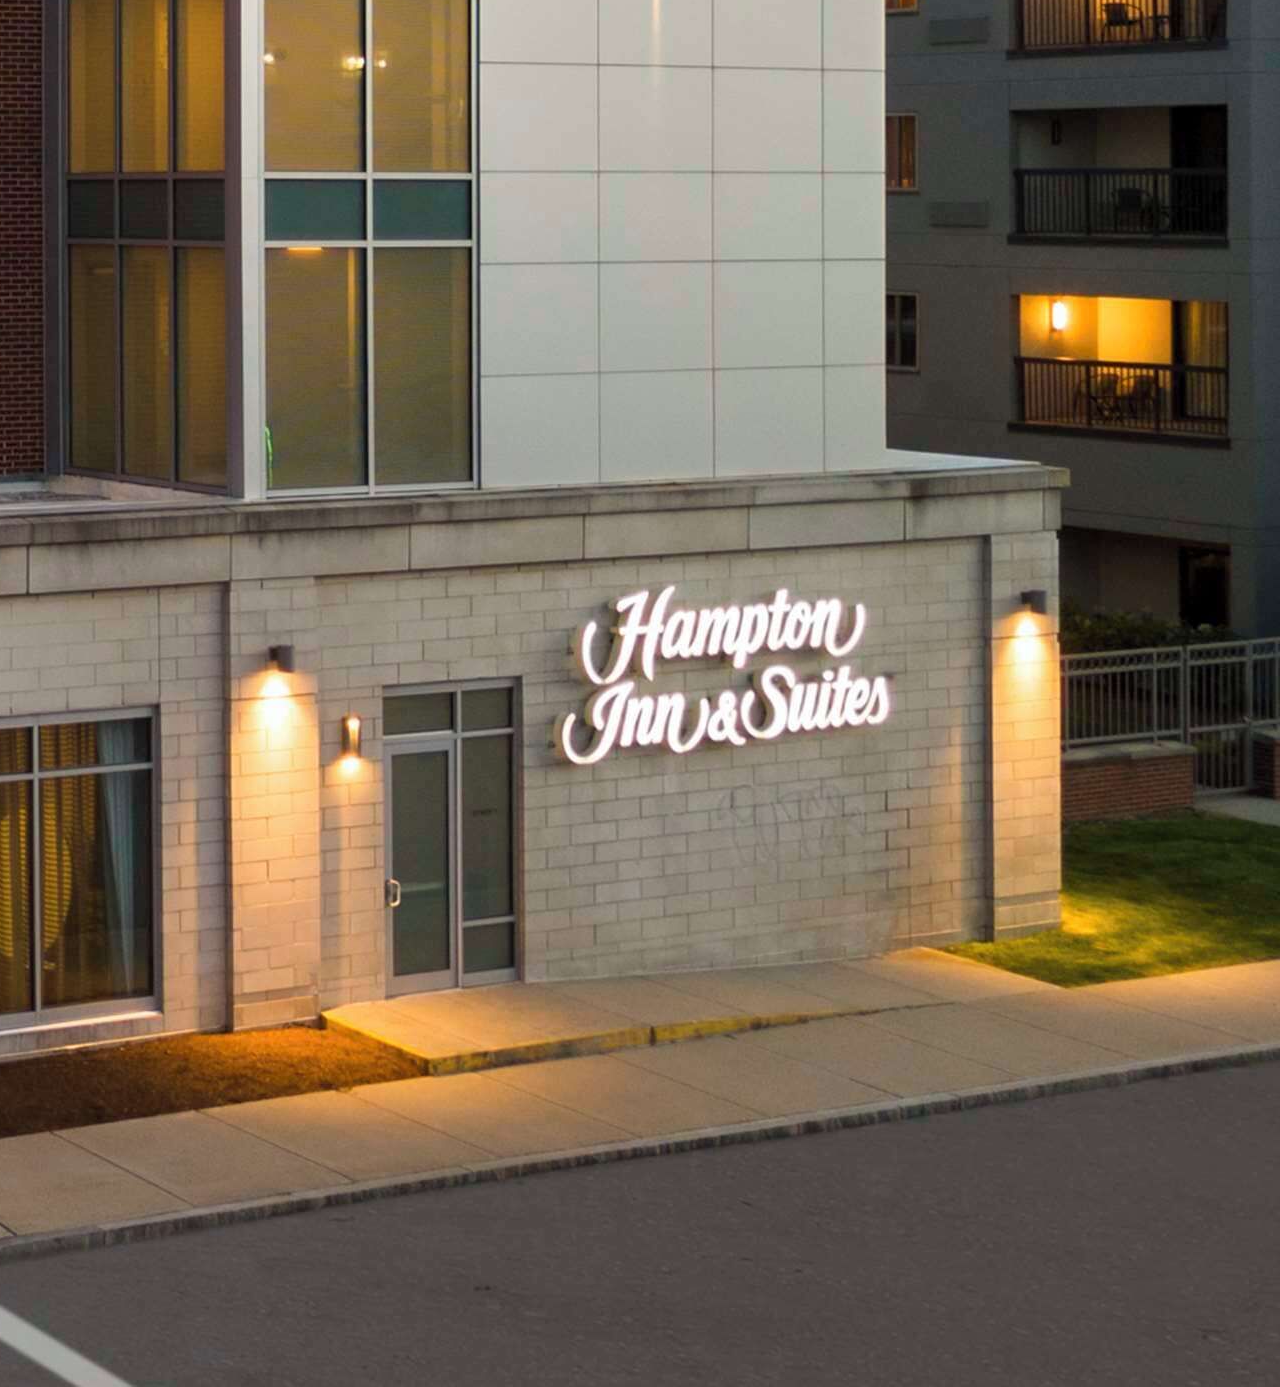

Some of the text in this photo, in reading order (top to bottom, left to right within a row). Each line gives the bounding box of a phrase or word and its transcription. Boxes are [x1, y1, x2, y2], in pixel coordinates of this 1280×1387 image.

[581, 585, 866, 685] Hampton
[562, 664, 891, 765] Inn & Suites
